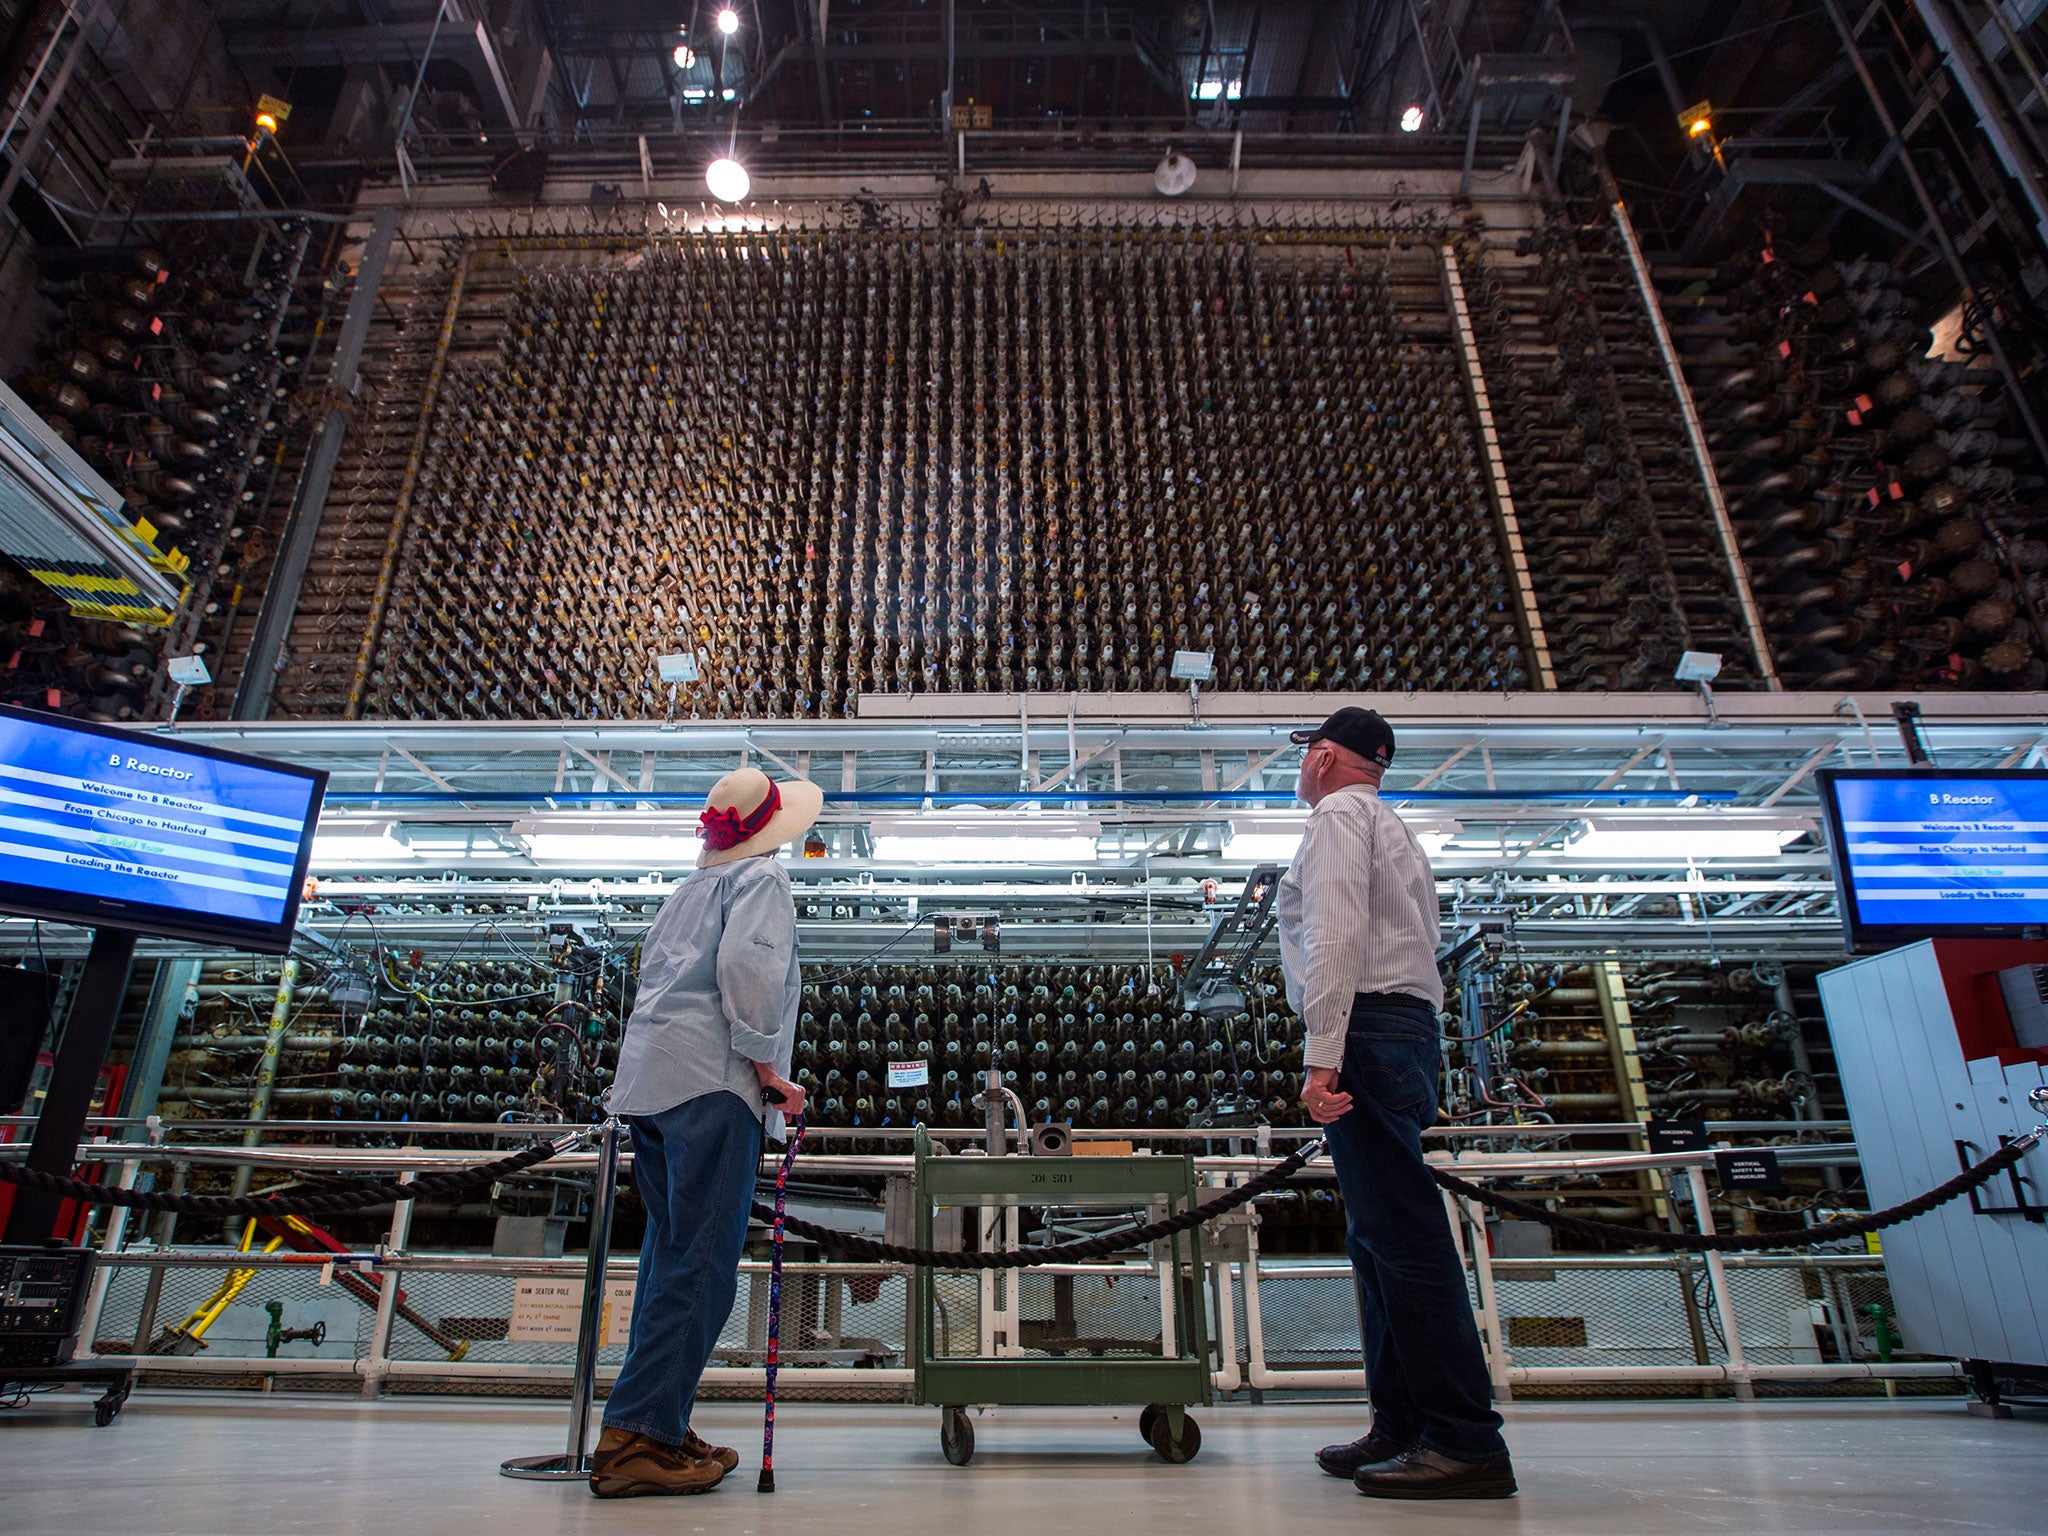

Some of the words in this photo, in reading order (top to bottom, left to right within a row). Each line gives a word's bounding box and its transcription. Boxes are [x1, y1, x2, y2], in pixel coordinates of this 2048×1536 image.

[109, 754, 121, 767] B
[127, 758, 194, 782] Reactor
[82, 781, 134, 800] Welcome
[137, 792, 148, 802] to
[152, 794, 159, 803] B
[162, 796, 204, 812] Reactor
[1930, 794, 1940, 805] B
[1943, 794, 1994, 805] Reactor
[64, 803, 93, 816] From
[97, 809, 143, 826] Chicago
[147, 819, 158, 828] to
[162, 821, 207, 836] Hanford
[97, 834, 106, 844] A
[109, 836, 137, 848] Brief
[140, 840, 165, 853] Tour
[1942, 845, 1977, 854] Chicago
[65, 855, 112, 871] Loading
[115, 862, 133, 873] the
[136, 866, 179, 881] Reactor
[1940, 891, 1975, 900] Loading
[270, 1020, 282, 1028] 07
